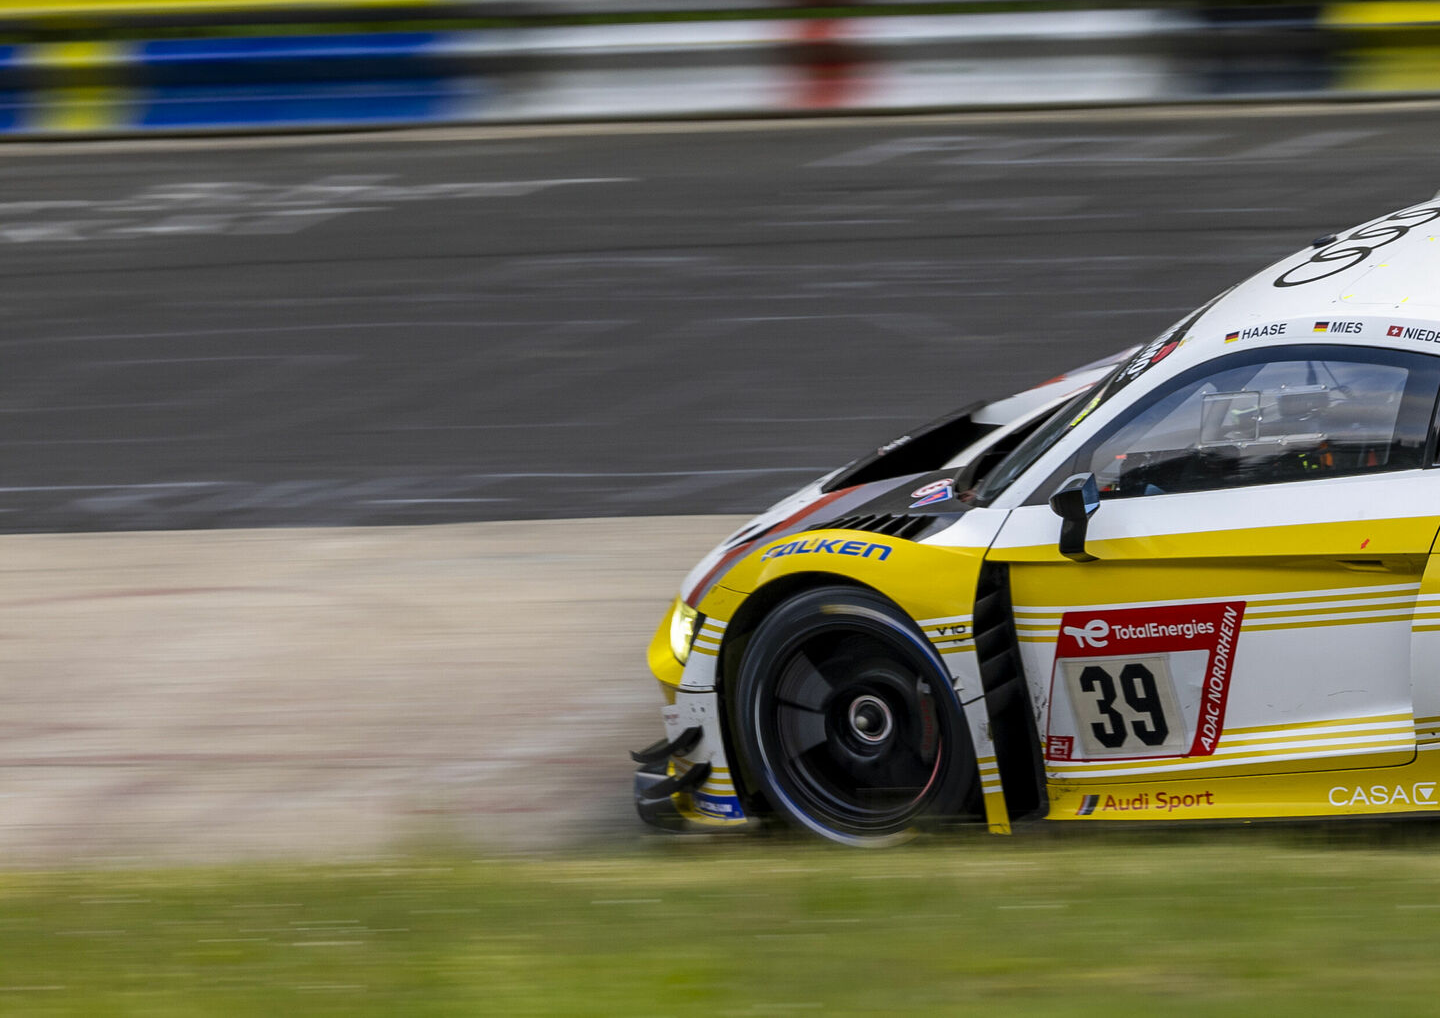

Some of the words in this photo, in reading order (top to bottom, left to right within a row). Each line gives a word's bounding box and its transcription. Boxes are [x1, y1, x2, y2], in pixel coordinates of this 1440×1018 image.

[1241, 323, 1288, 340] HAASE
[1330, 321, 1364, 334] MIES
[760, 539, 893, 561] FALKEN
[1111, 619, 1215, 639] TotalEnergies
[1208, 605, 1238, 704] NORDRHEIN
[1079, 663, 1170, 749] 39
[1200, 703, 1220, 751] ADAC
[1102, 793, 1150, 811] Audi
[1155, 790, 1215, 812] Sport
[1328, 783, 1409, 806] CASA
